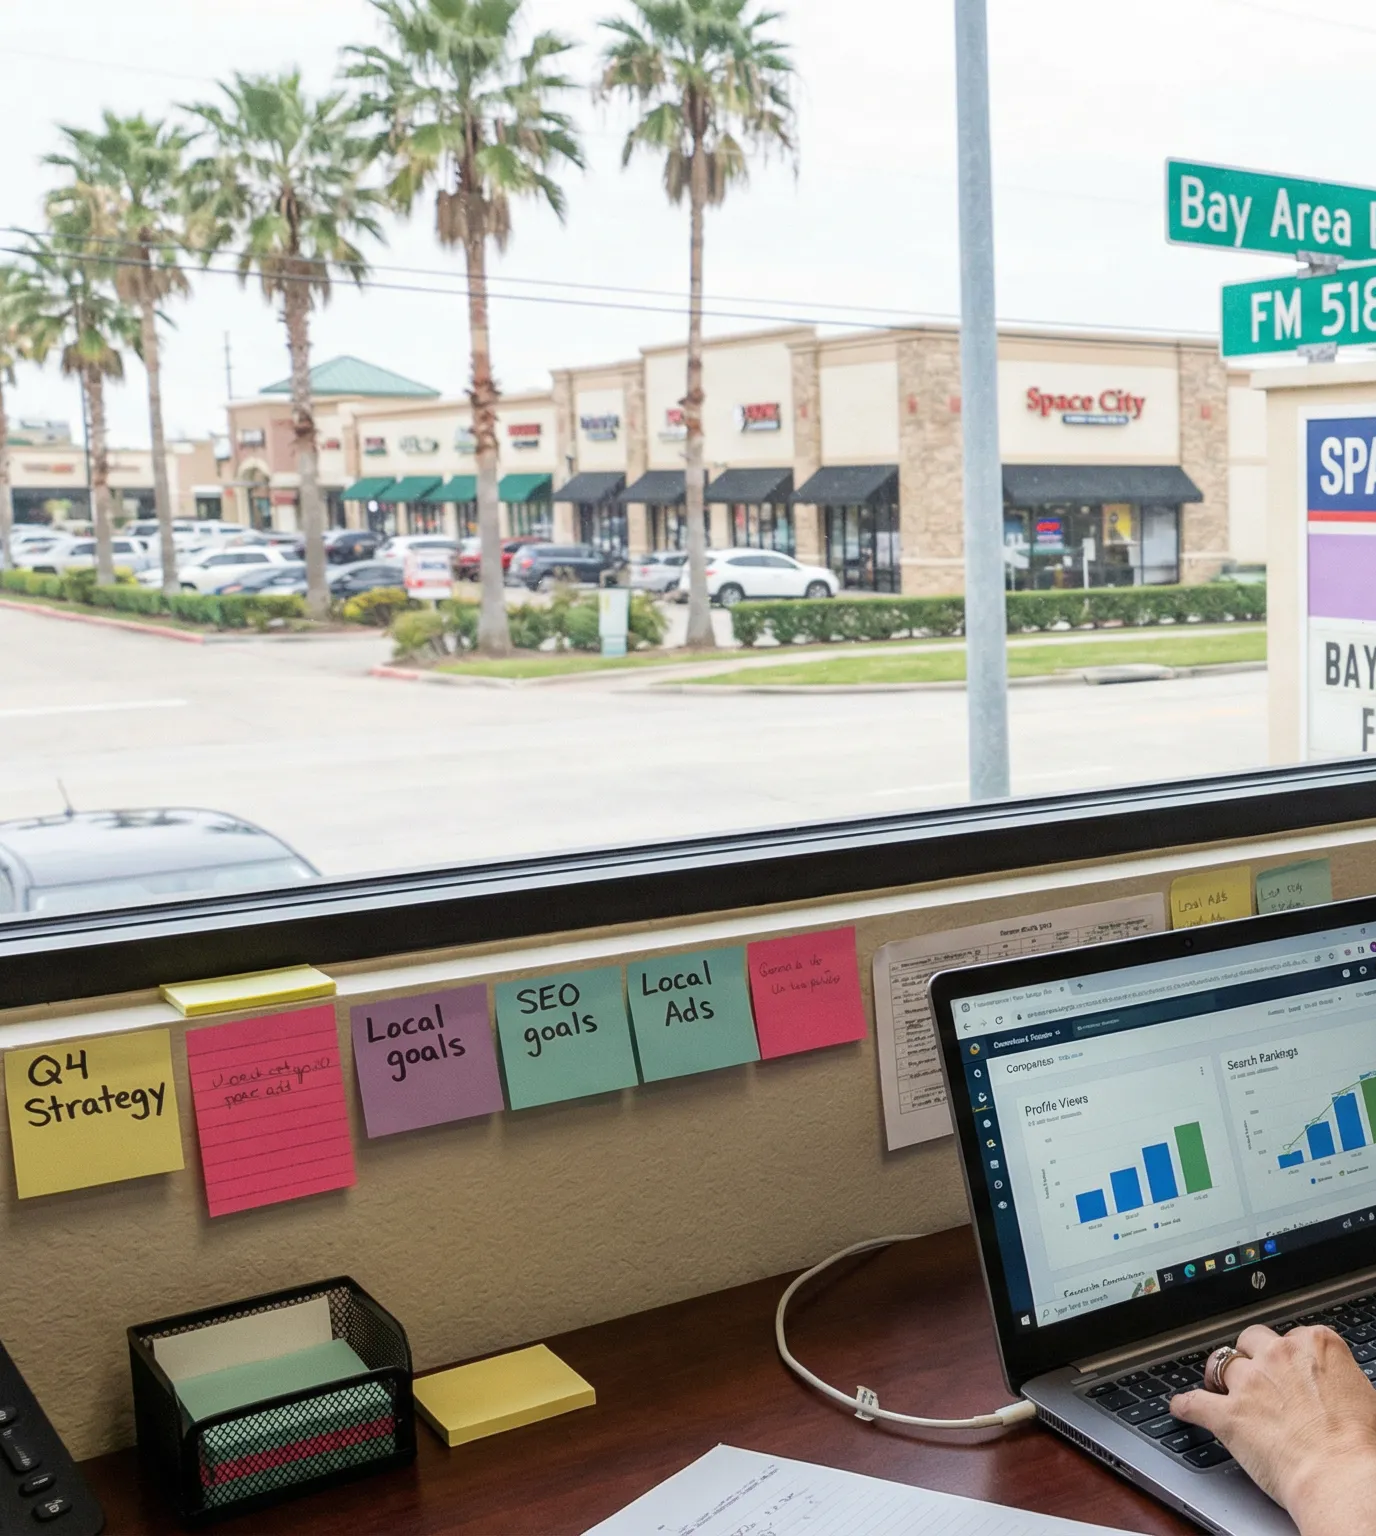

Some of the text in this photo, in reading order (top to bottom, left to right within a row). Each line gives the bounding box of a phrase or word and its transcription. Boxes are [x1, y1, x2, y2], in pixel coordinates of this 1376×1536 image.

[1180, 175, 1252, 248] Bay
[1270, 188, 1352, 247] Area
[1251, 287, 1302, 342] FM
[1026, 386, 1145, 420] Space City
[642, 959, 712, 996] Local
[516, 983, 580, 1014] SEO
[665, 996, 715, 1027] Ads
[366, 1004, 444, 1043] Local
[523, 1011, 598, 1057] goals
[27, 1050, 88, 1087] Q4
[386, 1034, 466, 1082] goals
[24, 1082, 165, 1127] Strategy
[1024, 1094, 1089, 1117] Profile Views
